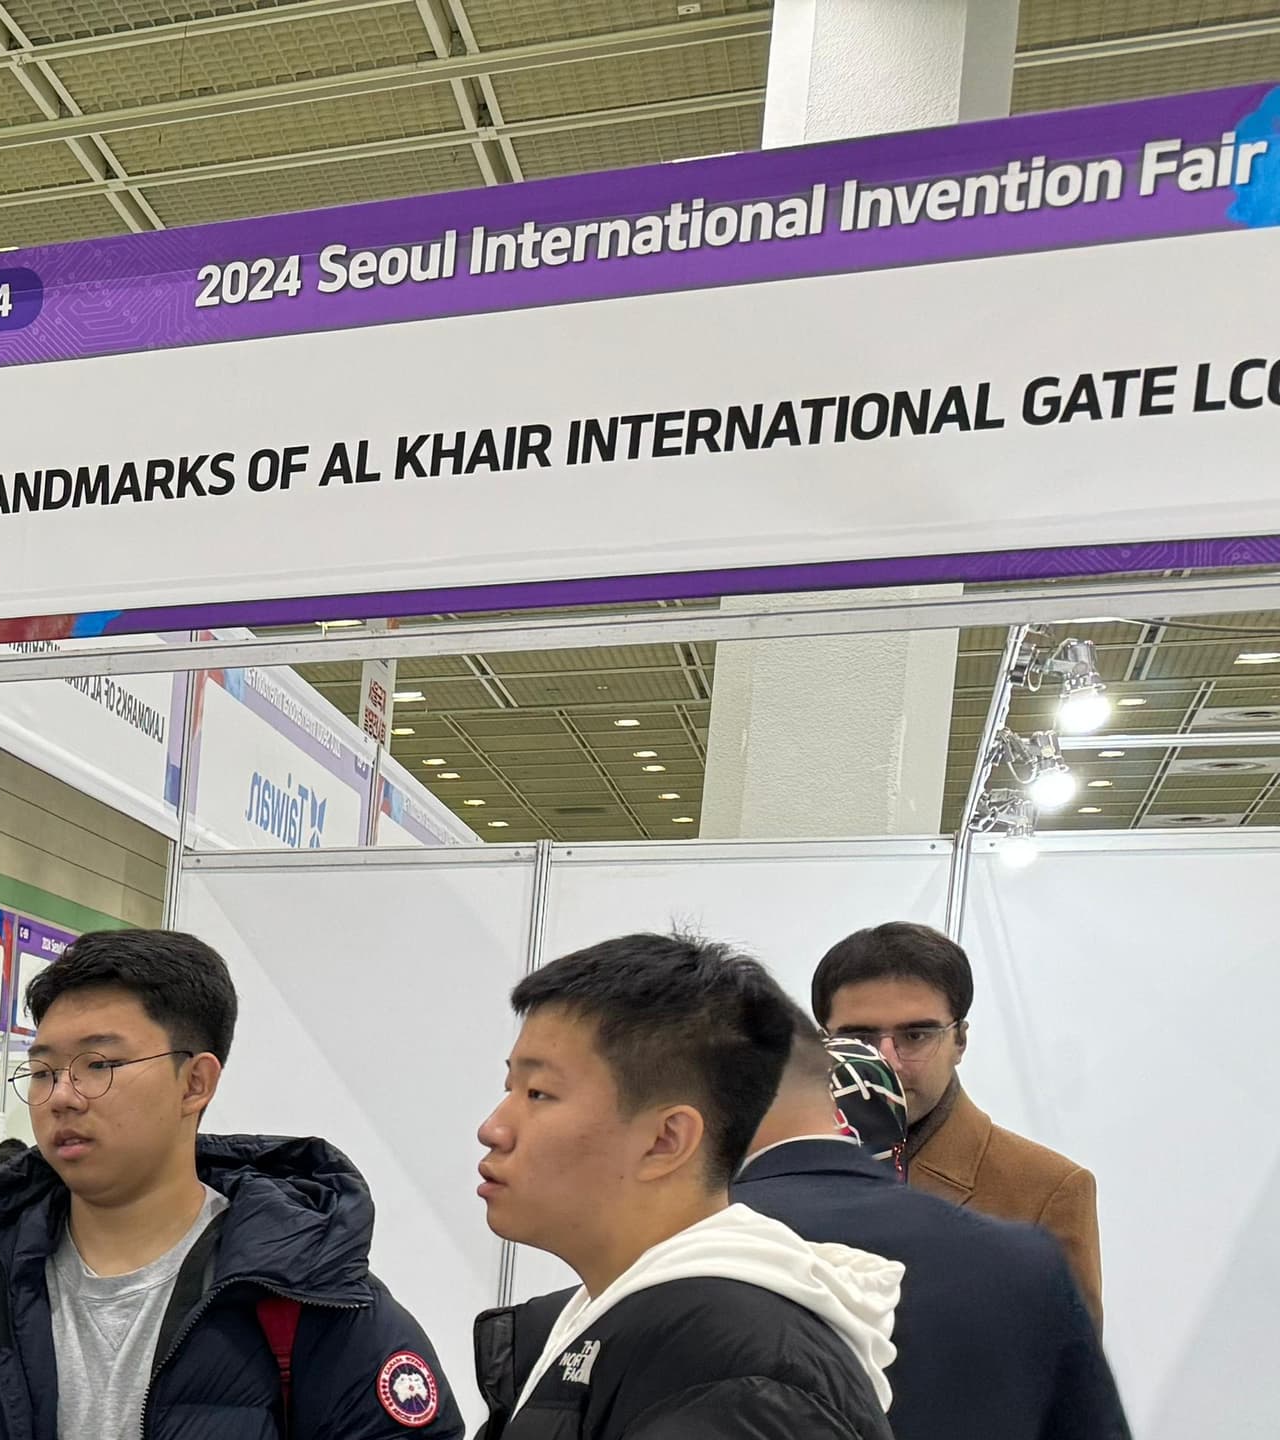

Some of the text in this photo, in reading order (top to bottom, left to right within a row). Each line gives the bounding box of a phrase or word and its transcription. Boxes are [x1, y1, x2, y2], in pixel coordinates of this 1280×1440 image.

[194, 132, 1268, 310] 2024 Seoul International Invention Fair
[247, 445, 309, 492] OF
[319, 440, 381, 487] AL
[394, 423, 552, 480] KHAIR
[566, 382, 1005, 466] INTERNATIONAL
[1021, 365, 1178, 426] GATE
